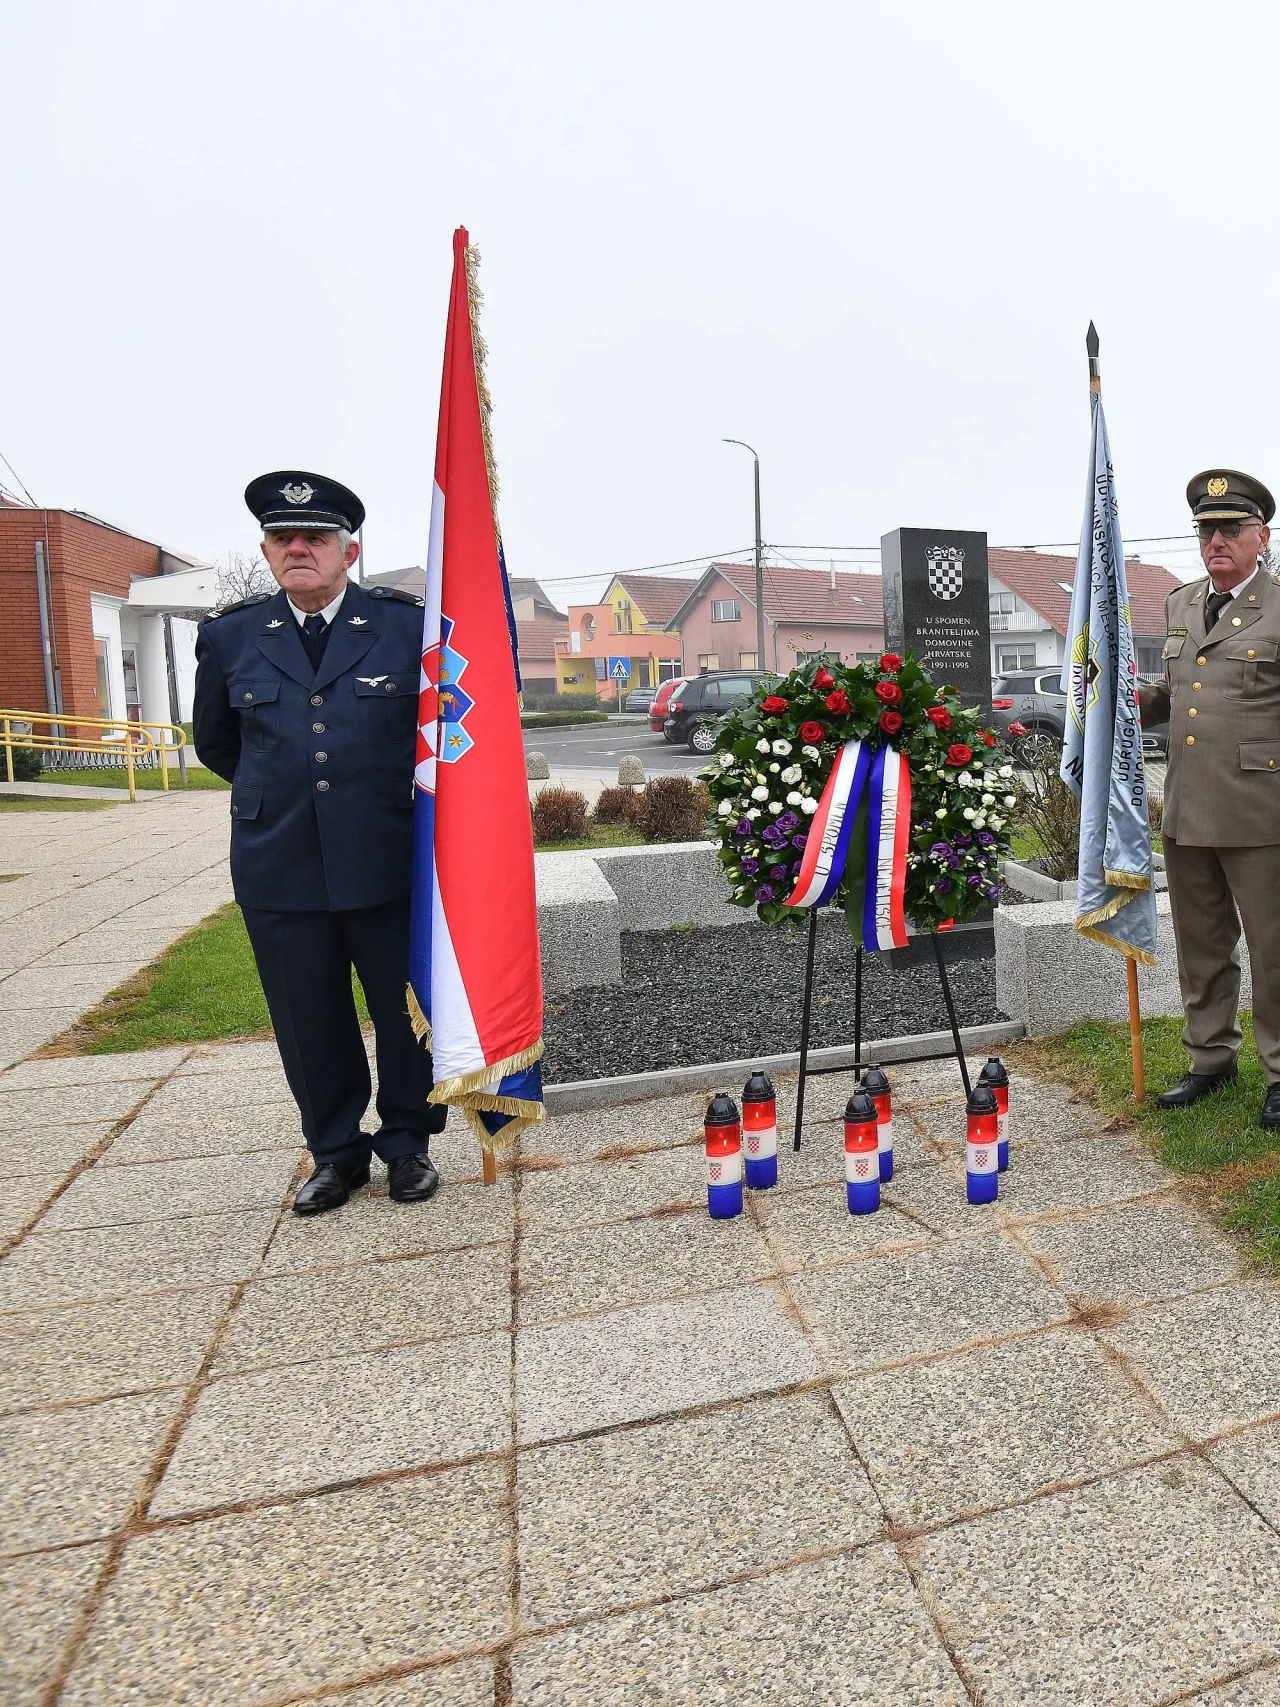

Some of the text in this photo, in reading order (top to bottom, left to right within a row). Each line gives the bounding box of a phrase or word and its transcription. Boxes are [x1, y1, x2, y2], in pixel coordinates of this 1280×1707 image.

[935, 617, 971, 625] SPOMEN
[916, 628, 980, 636] BRANITELJIMA
[925, 639, 973, 647] DOMOVINE
[927, 650, 972, 658] HRVATSKE
[1118, 716, 1136, 782] UDRUGA
[821, 801, 847, 858] SPOMEN
